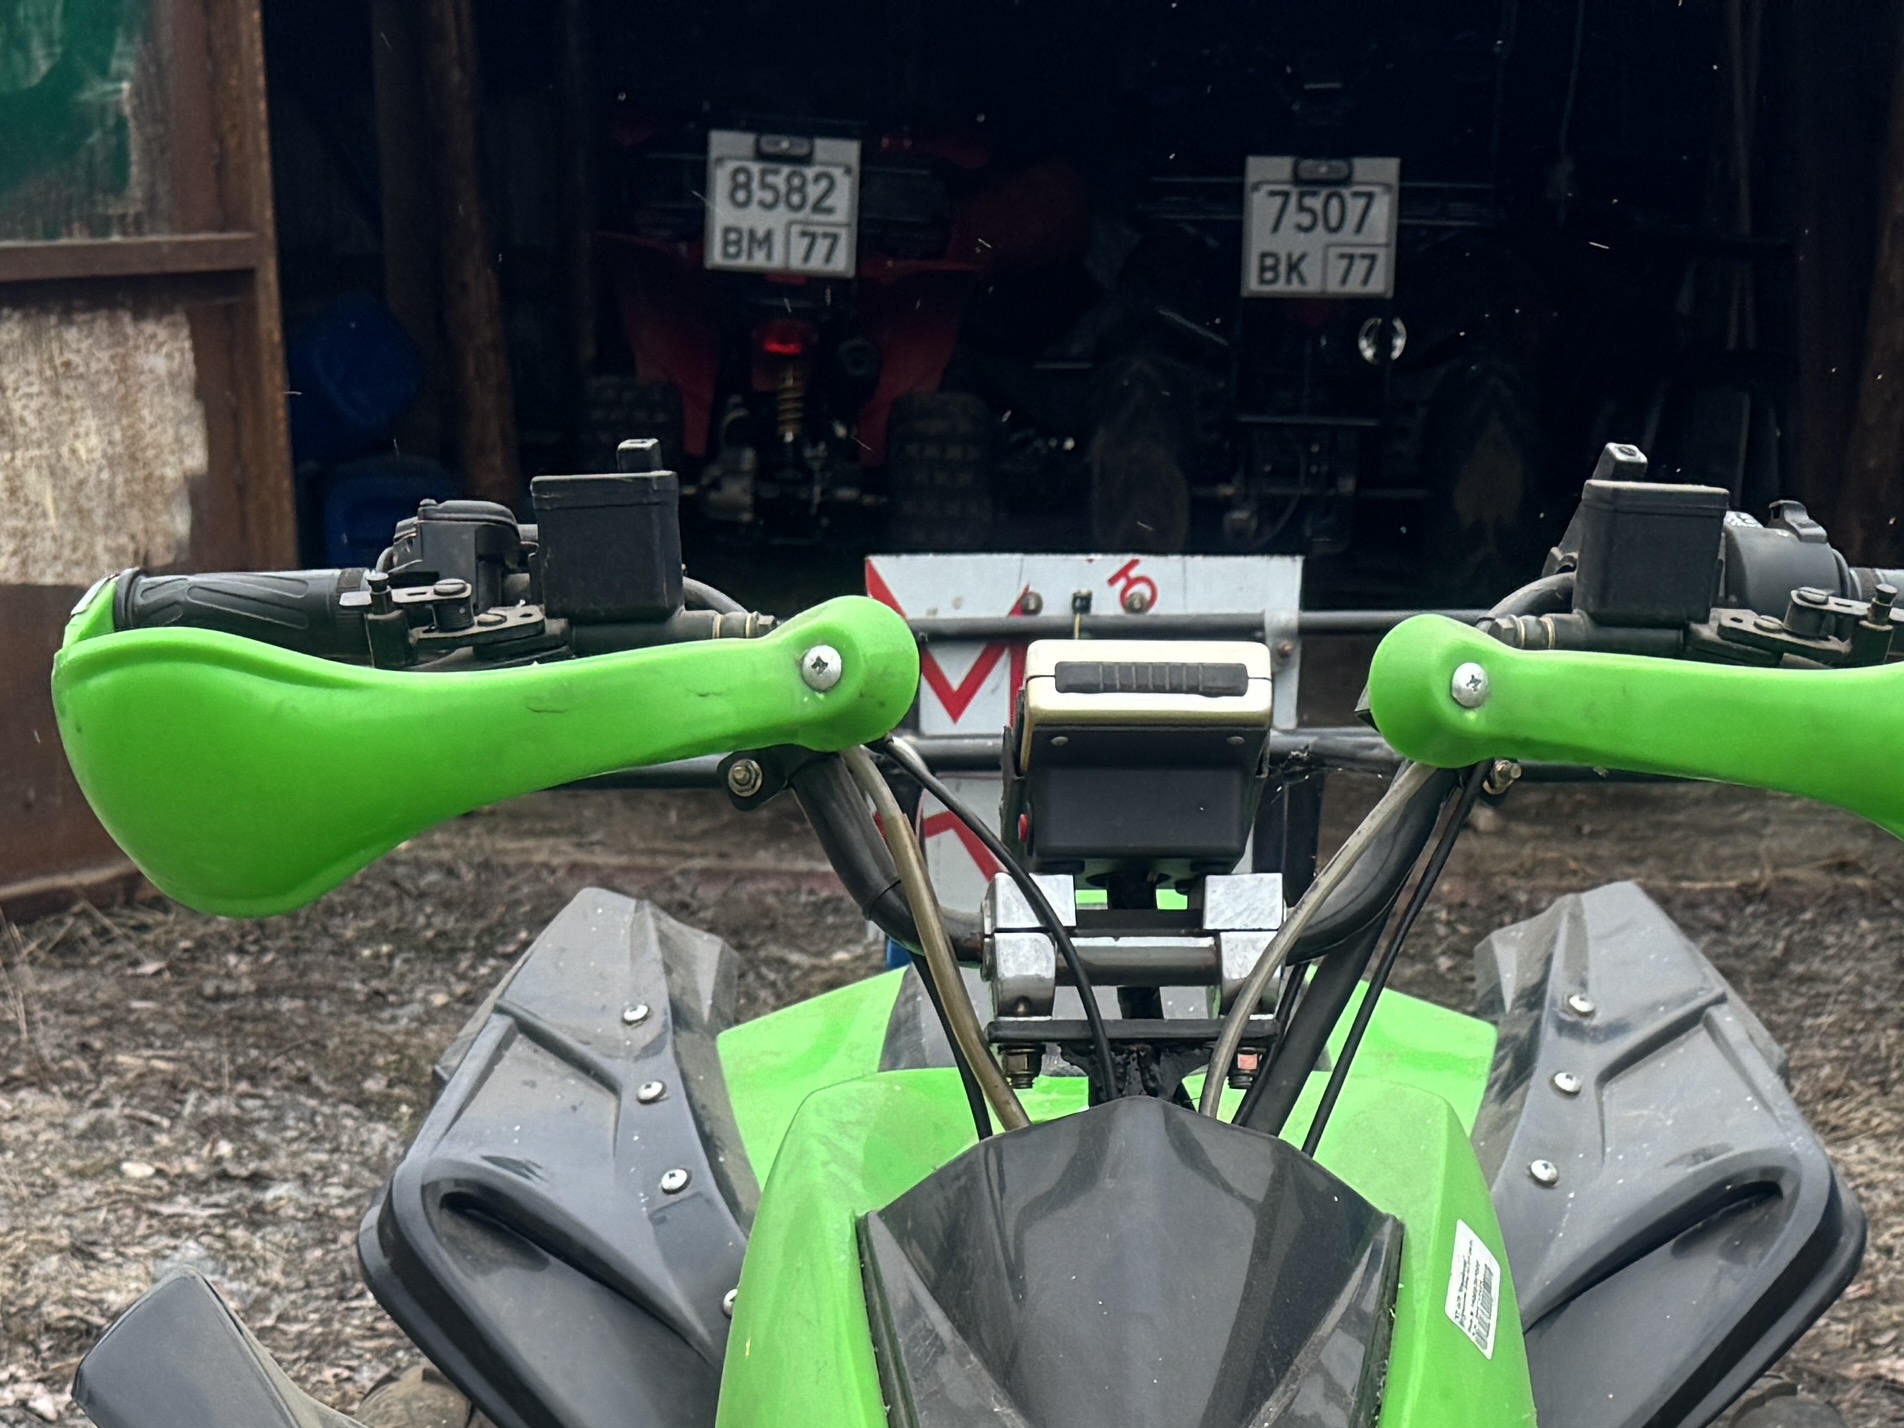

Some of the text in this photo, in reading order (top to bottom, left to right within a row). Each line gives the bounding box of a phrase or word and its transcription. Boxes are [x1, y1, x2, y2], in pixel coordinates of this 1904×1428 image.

[729, 166, 837, 214] 8582
[1267, 189, 1376, 235] 7507
[799, 230, 840, 265] 77
[1336, 252, 1378, 287] 77
